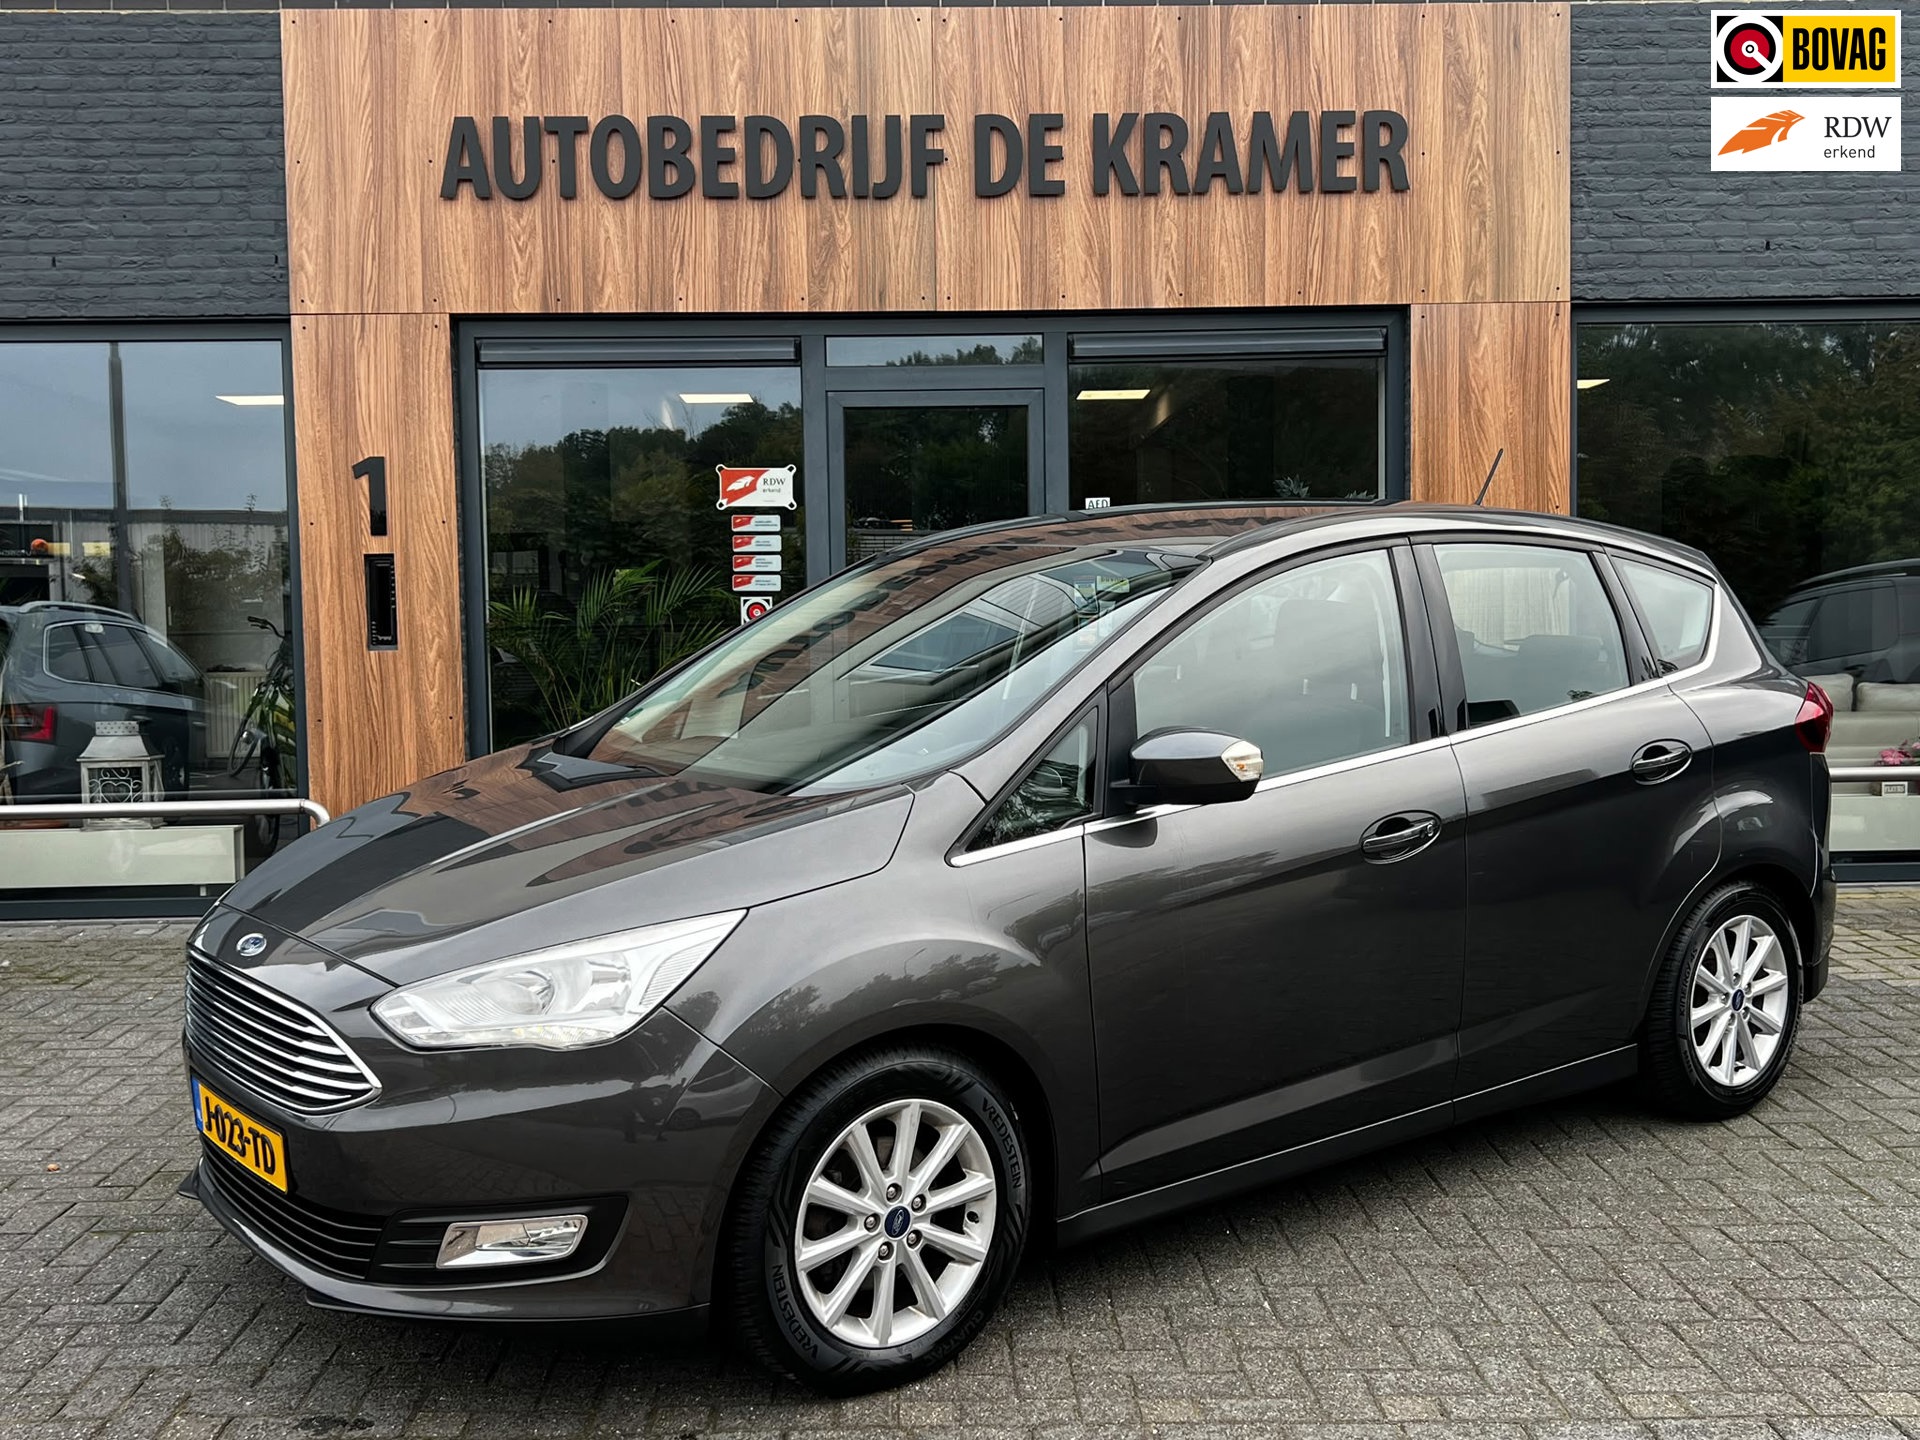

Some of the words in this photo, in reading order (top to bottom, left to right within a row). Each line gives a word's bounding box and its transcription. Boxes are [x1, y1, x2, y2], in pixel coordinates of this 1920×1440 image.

[440, 114, 946, 199] AUTOBEDRIJF
[974, 113, 1066, 196] DE
[1092, 110, 1410, 195] KRAMER
[352, 456, 388, 536] 1
[762, 478, 786, 486] RDW
[1088, 499, 1109, 509] AED
[205, 1095, 276, 1176] J-023-TD
[982, 1096, 1022, 1188] VREDESTEIN
[772, 1263, 818, 1359] VREDESTEIN
